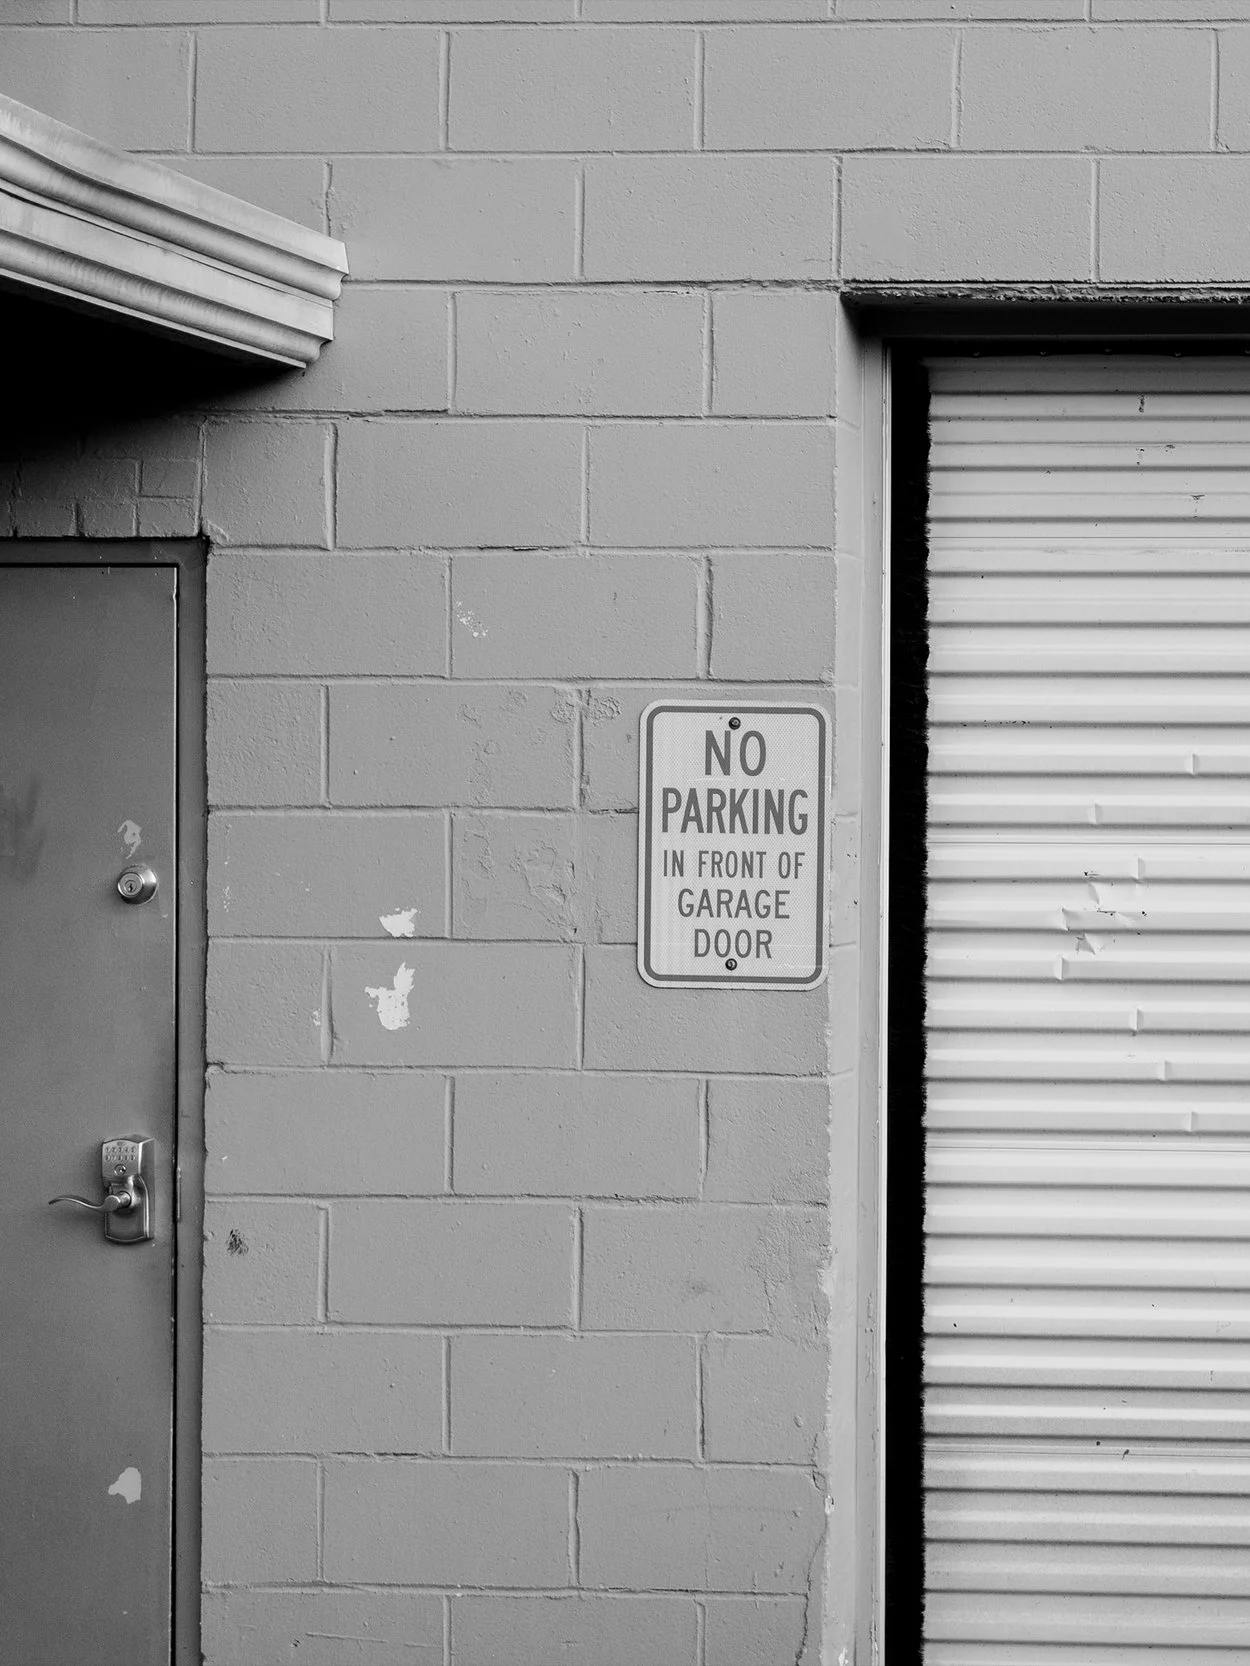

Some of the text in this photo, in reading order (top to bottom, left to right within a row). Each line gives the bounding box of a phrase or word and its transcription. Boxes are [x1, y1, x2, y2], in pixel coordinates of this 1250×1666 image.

[705, 730, 766, 776] NO
[661, 787, 808, 835] PARKING
[663, 849, 806, 879] IN FRONT OF
[677, 888, 790, 919] GARAGE
[694, 928, 772, 959] DOOR
